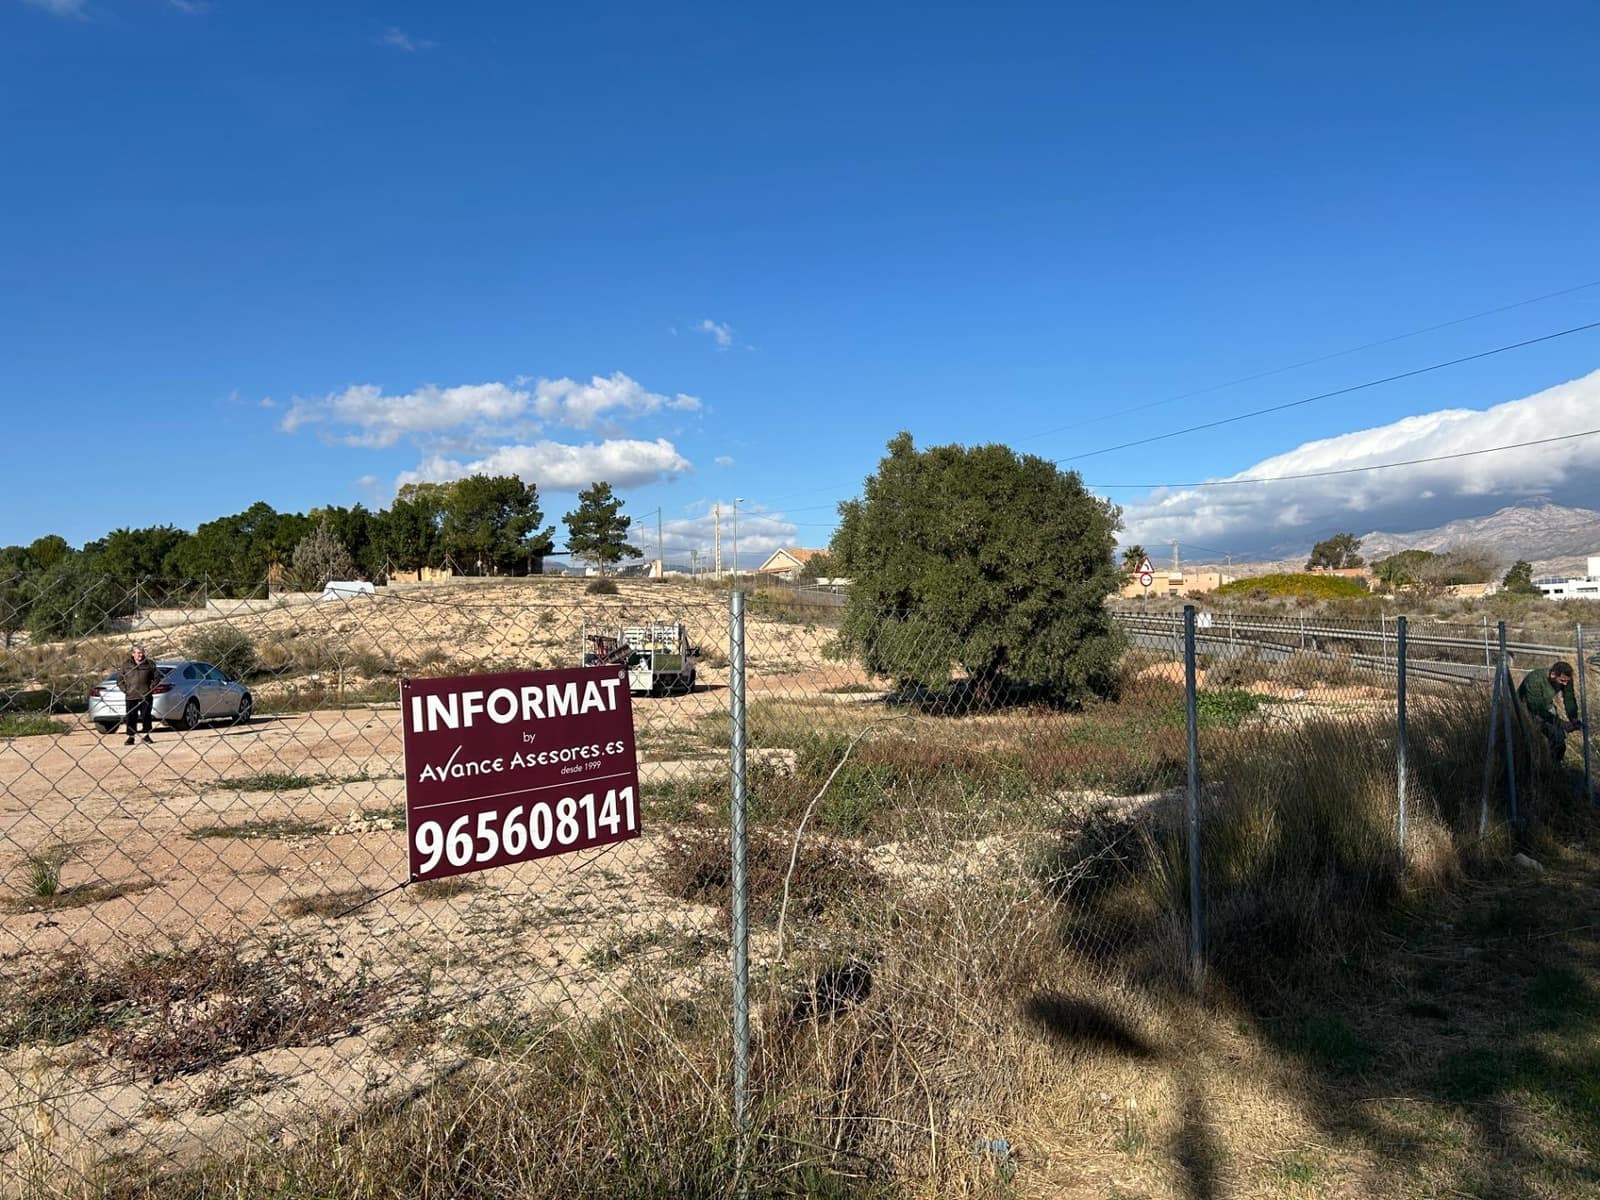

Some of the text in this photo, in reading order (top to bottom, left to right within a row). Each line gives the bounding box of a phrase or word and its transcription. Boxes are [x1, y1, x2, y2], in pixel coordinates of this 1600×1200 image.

[411, 678, 620, 733] INFORMAT
[523, 731, 536, 744] by
[560, 760, 602, 775] desde 1999
[415, 785, 637, 875] 965608141
